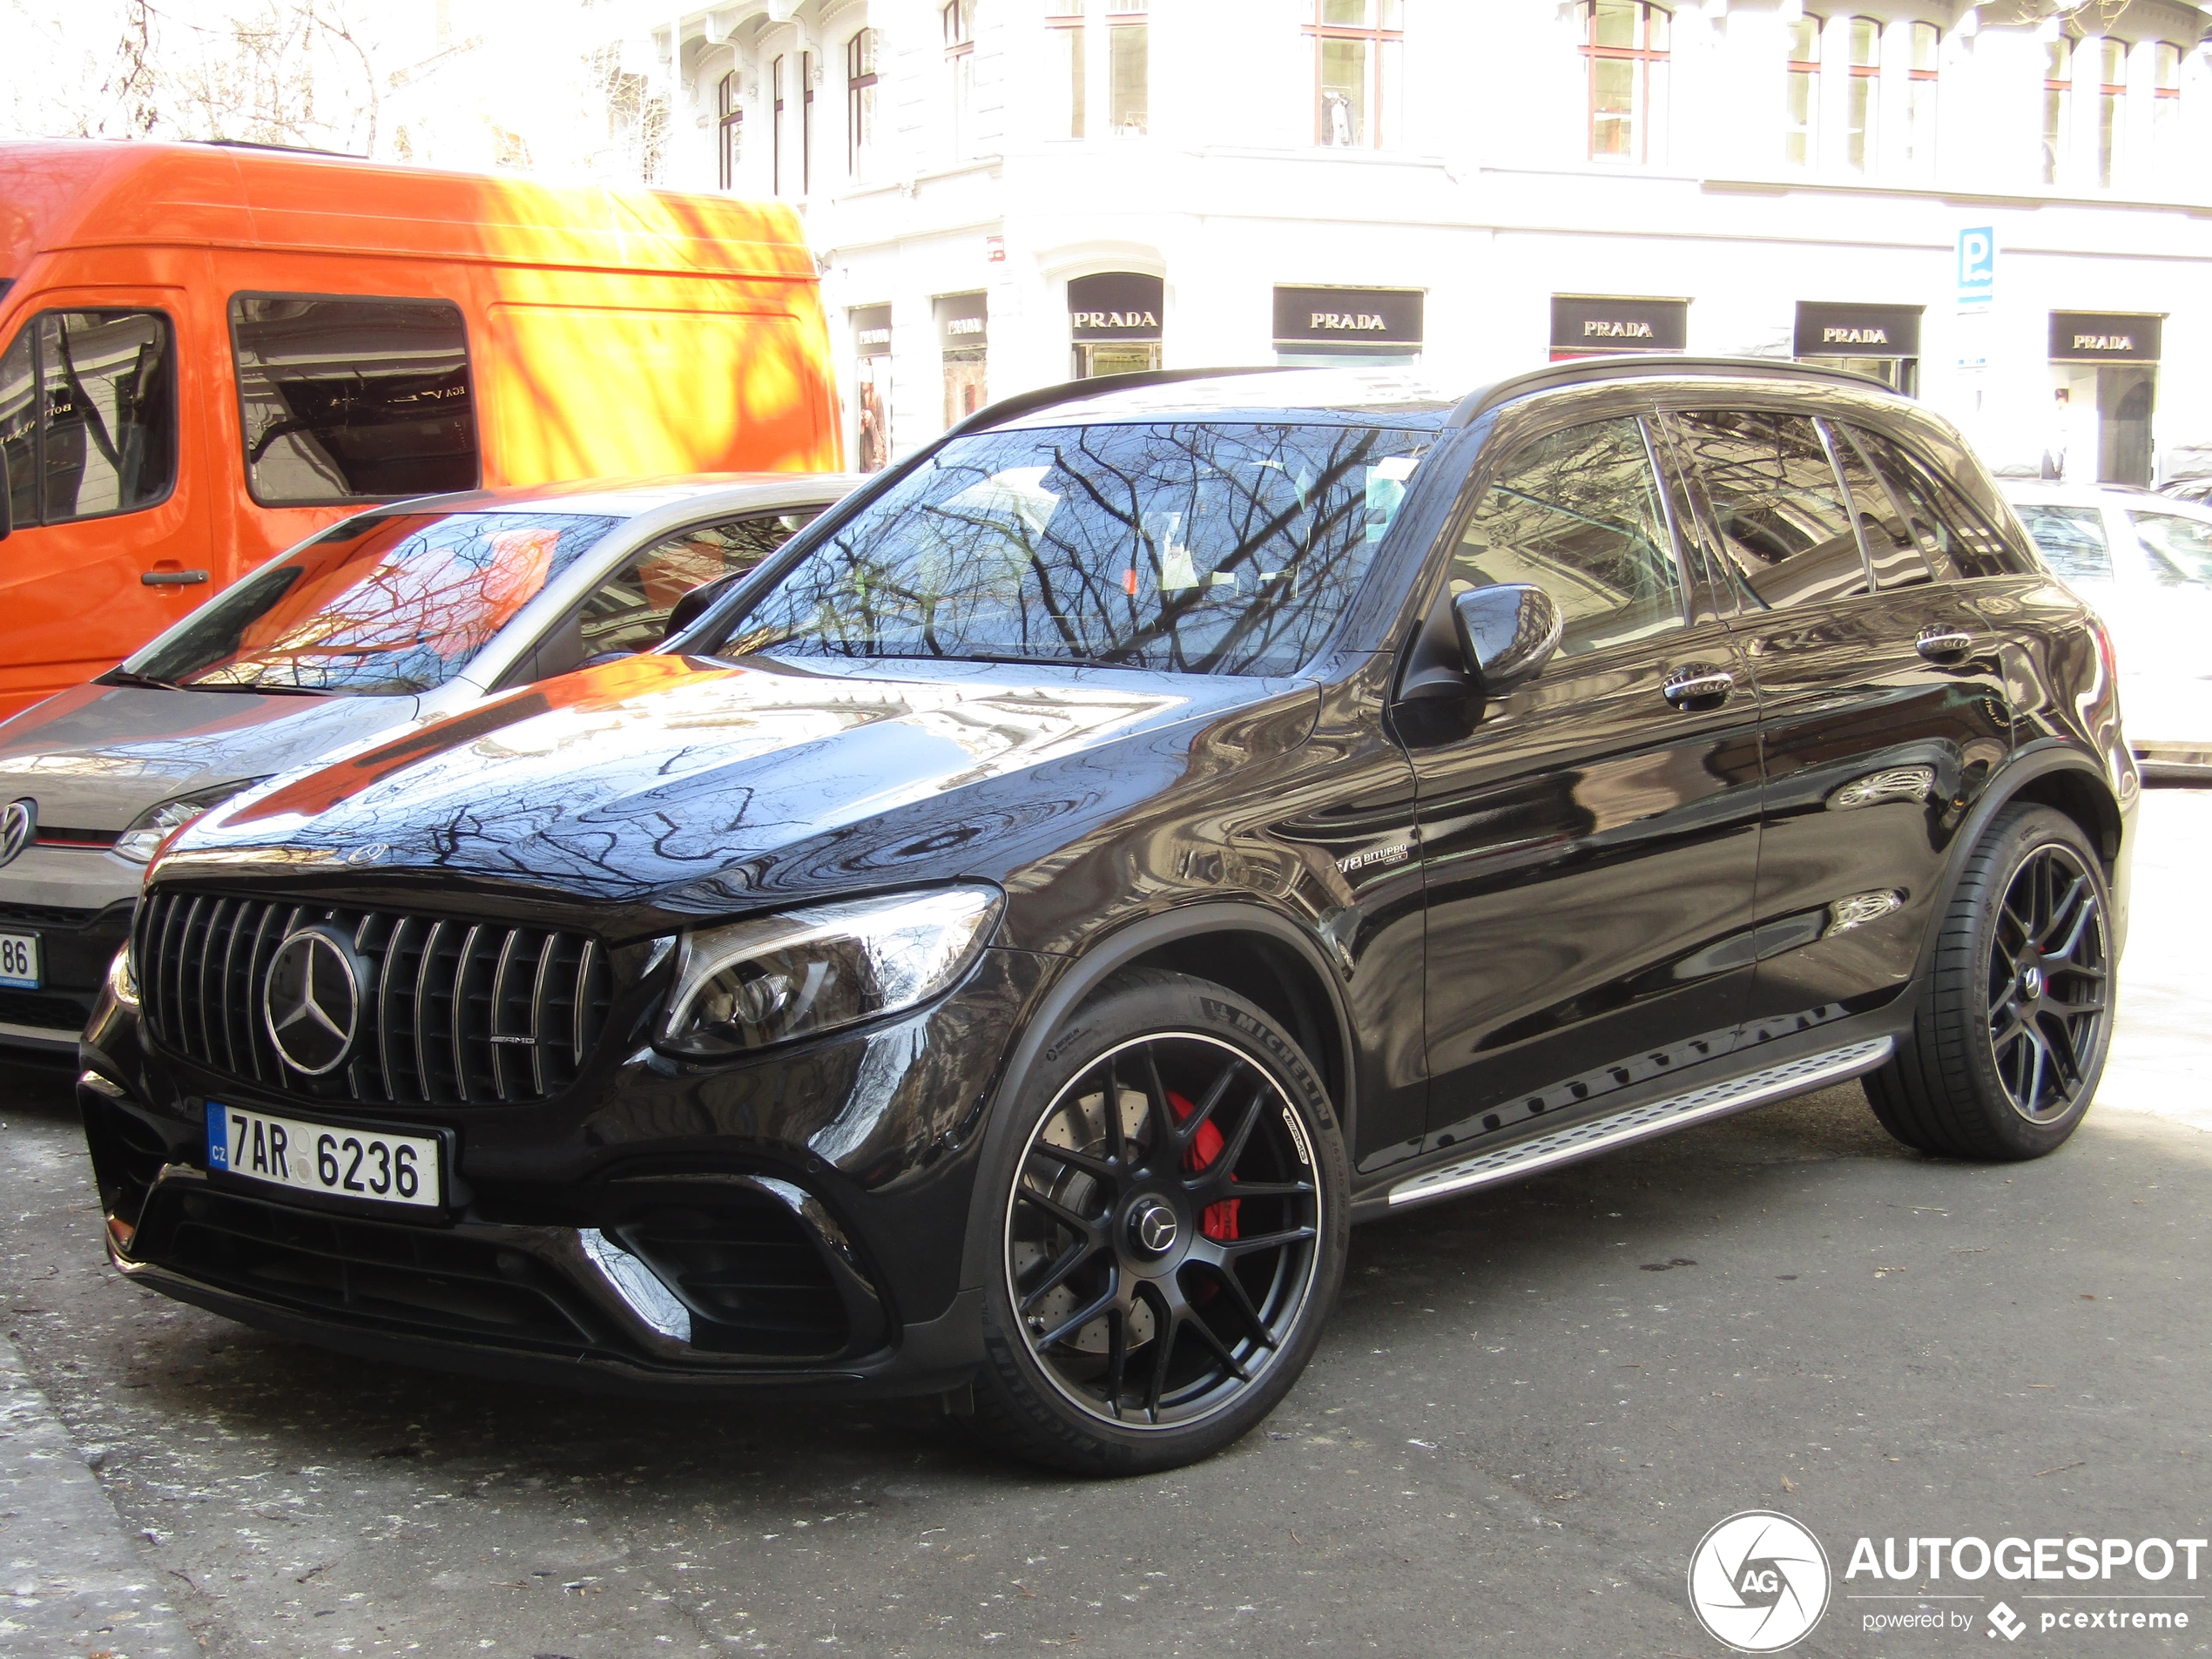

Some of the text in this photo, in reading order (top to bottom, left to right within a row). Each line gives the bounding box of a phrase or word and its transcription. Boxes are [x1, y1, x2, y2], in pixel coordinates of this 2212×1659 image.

[1961, 233, 1989, 282] P
[1072, 311, 1159, 328] PRADA
[1310, 313, 1387, 331] PRADA
[1583, 320, 1654, 339] PRADA
[1822, 327, 1888, 345] PRADA
[2072, 334, 2134, 350] PRADA
[1335, 843, 1406, 873] V8 BITURBO
[3, 940, 28, 974] 86
[1235, 1012, 1330, 1121] MICHELIN
[212, 1144, 226, 1162] CZ
[232, 1114, 419, 1197] 7AR 6236
